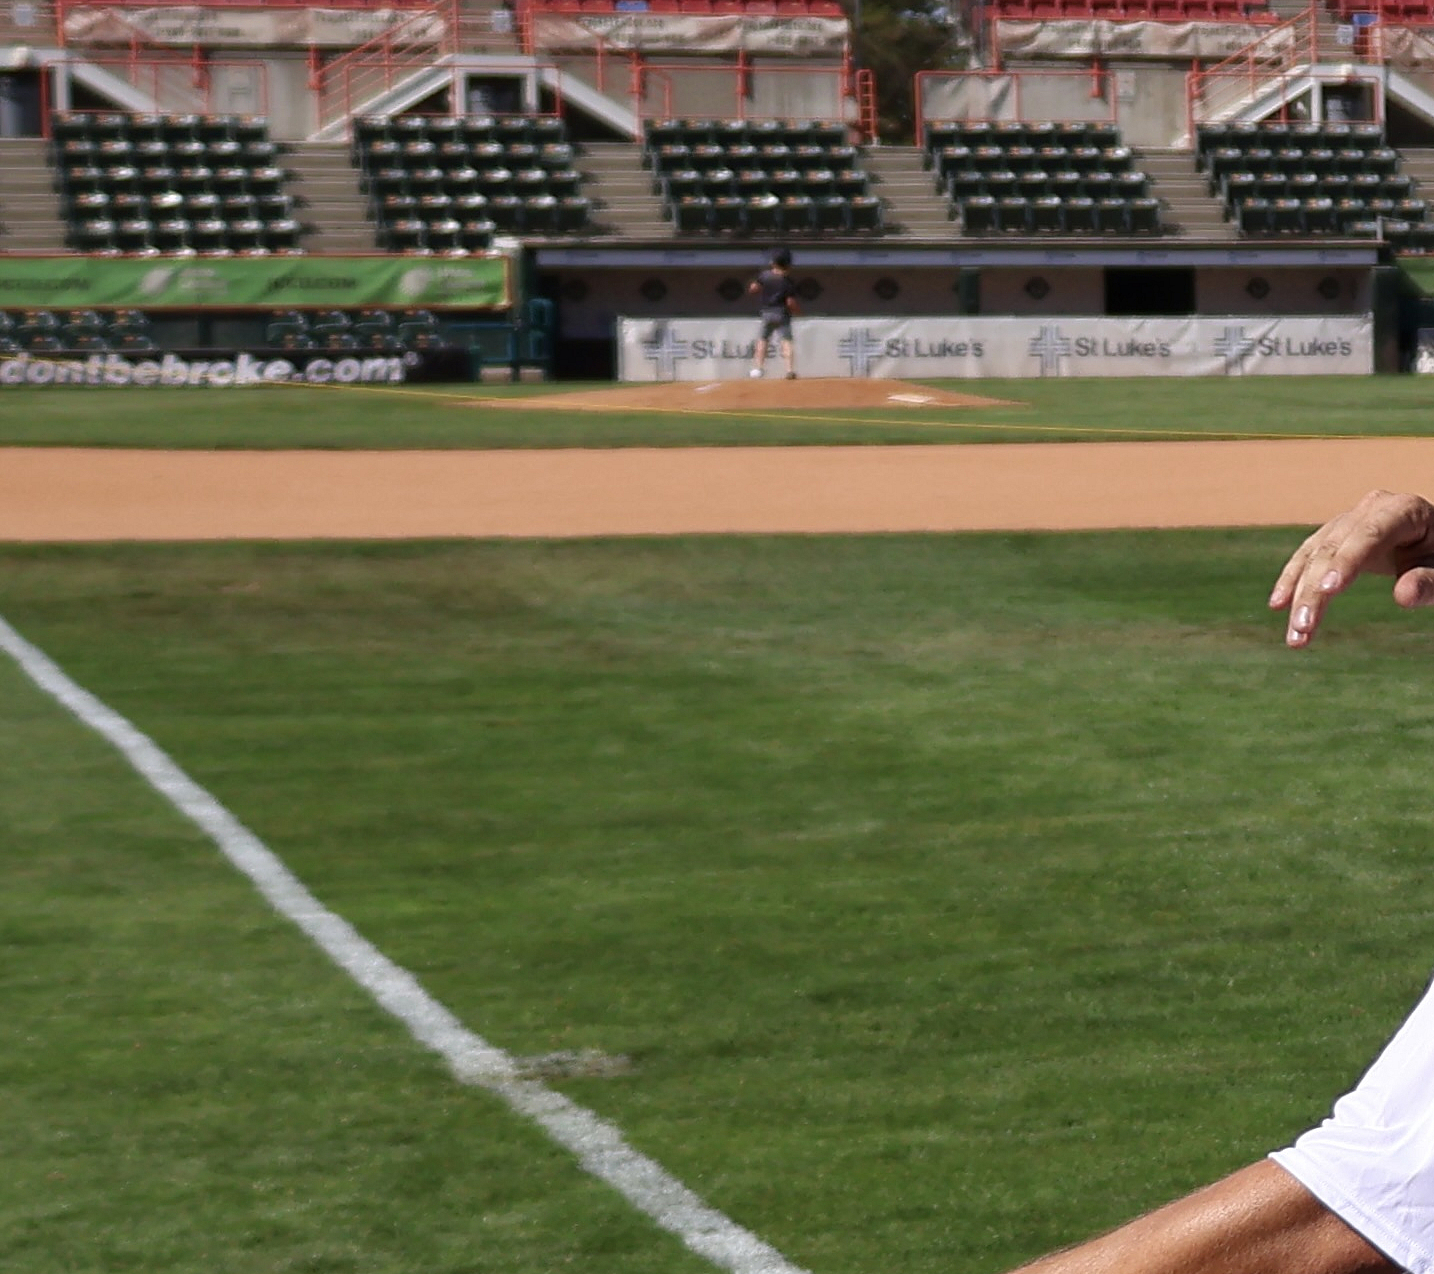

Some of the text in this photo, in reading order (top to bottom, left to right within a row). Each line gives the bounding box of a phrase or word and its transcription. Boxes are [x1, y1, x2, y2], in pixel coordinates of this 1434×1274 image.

[914, 337, 984, 359] Luke's
[1103, 337, 1172, 359] Luke's
[1286, 337, 1352, 359] Luke's
